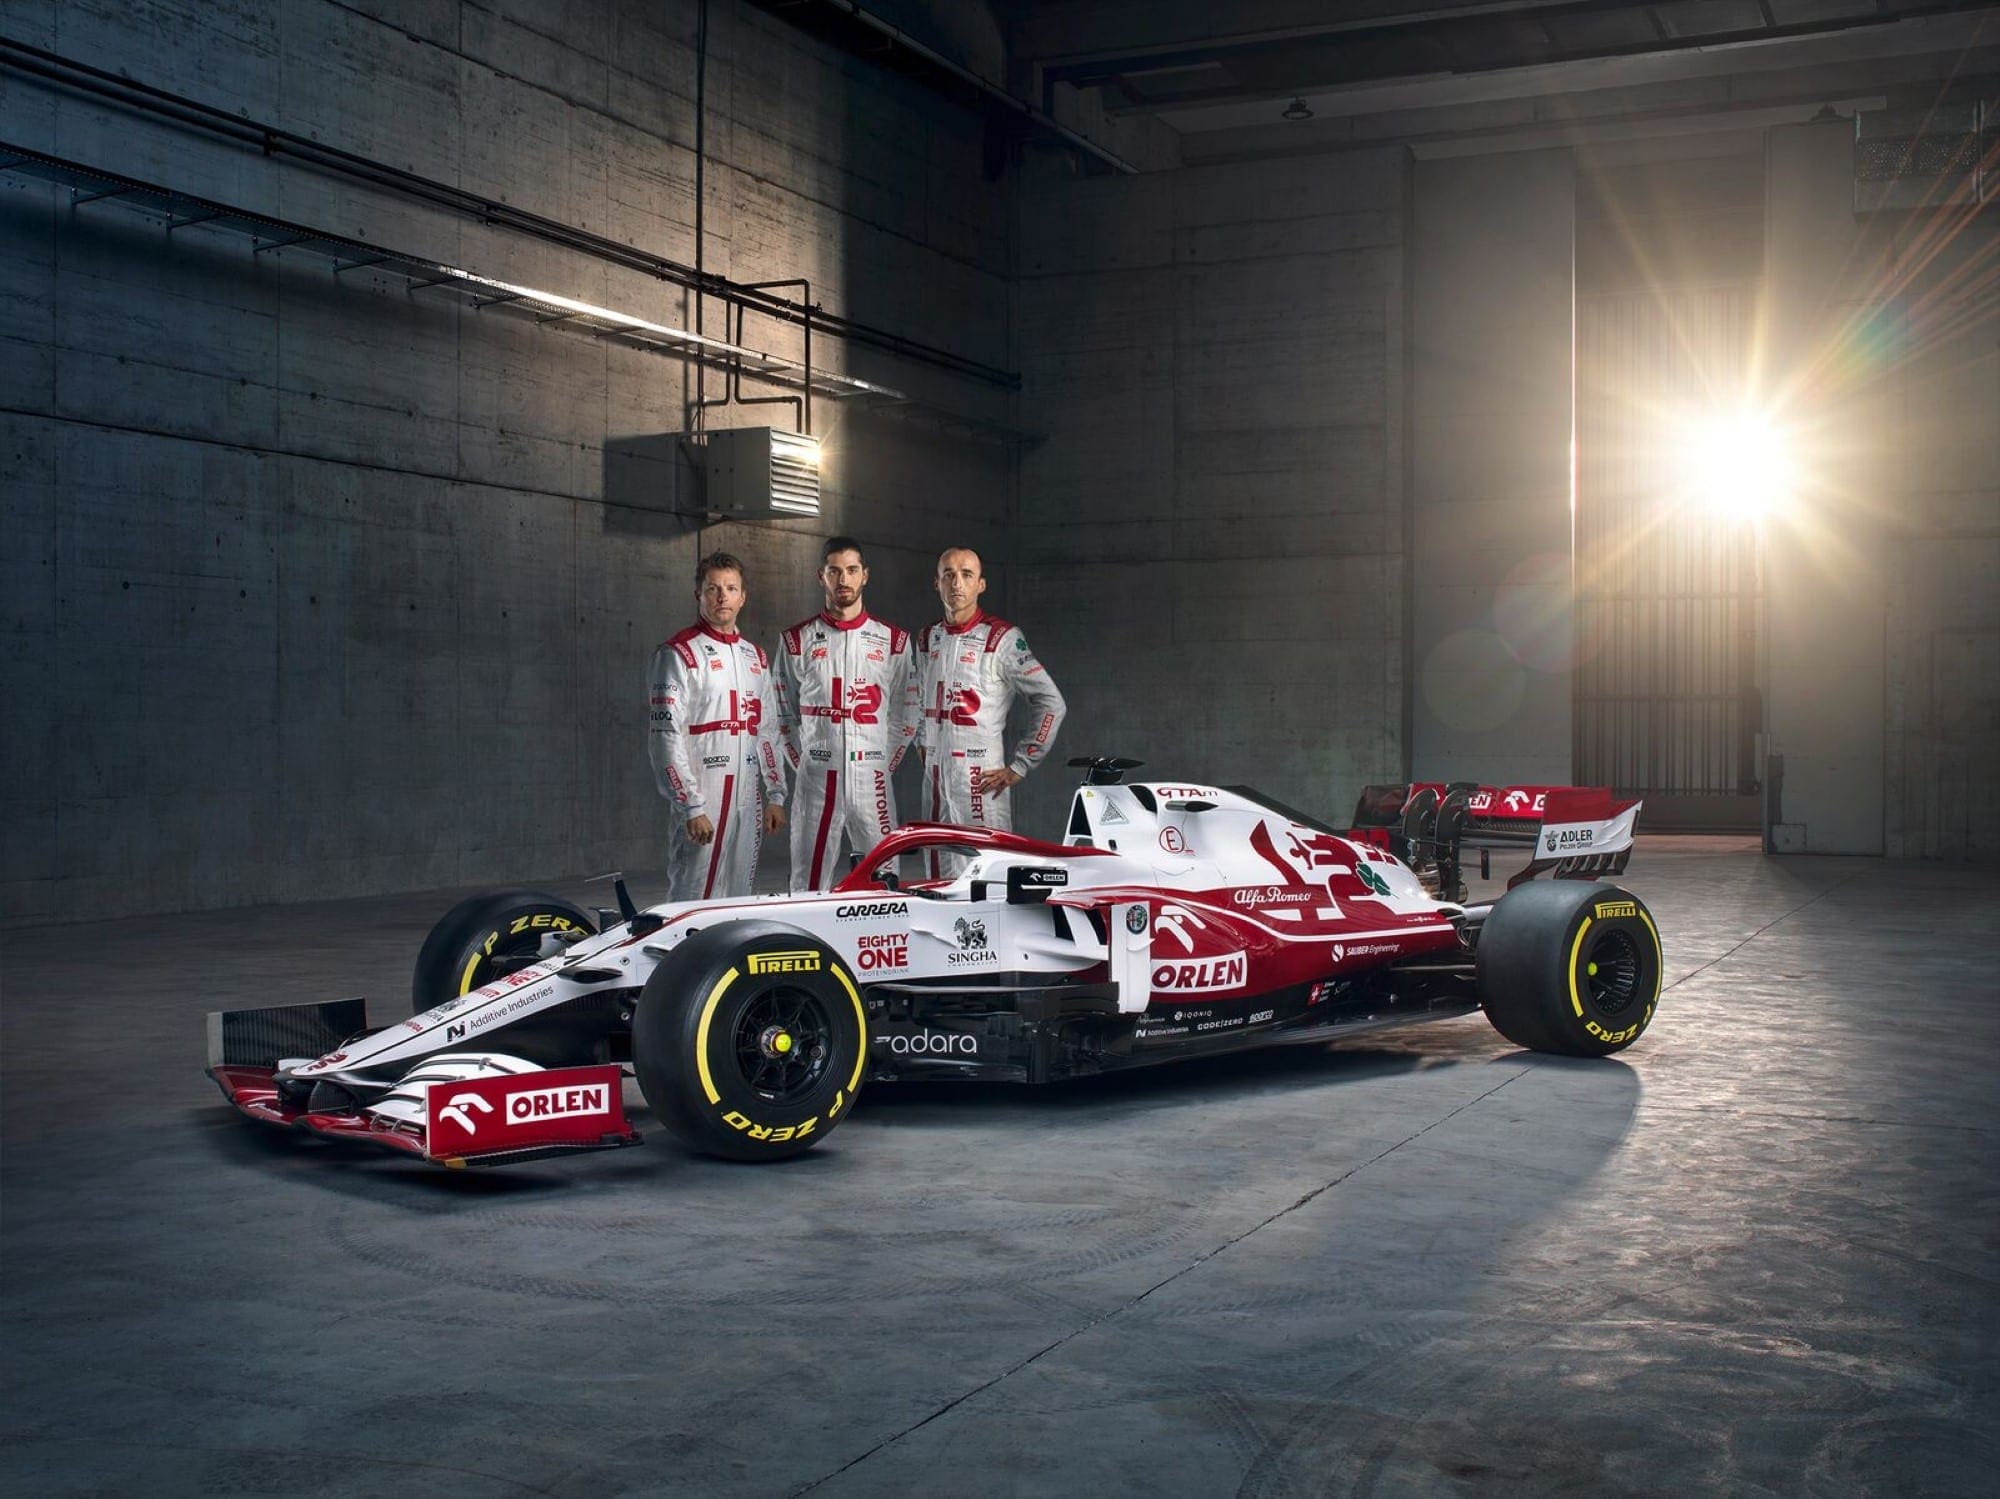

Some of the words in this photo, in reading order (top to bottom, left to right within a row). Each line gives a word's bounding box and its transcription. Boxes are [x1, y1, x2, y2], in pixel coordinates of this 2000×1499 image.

[873, 769, 892, 836] ANTONIO
[1560, 829, 1593, 843] ADLER
[836, 902, 909, 918] CARRERA
[1234, 889, 1267, 910] Alfa
[1266, 886, 1311, 903] Romeo
[1595, 901, 1636, 919] PIRELLI
[857, 933, 909, 949] EIGHTY
[747, 951, 821, 974] PIRELLI
[857, 947, 908, 970] ONE
[947, 950, 998, 964] SINGHA
[1152, 957, 1243, 988] ORLEN
[470, 1006, 508, 1031] Additive
[508, 985, 554, 1012] Industries
[1585, 1010, 1639, 1043] ZERO
[891, 1027, 977, 1053] adara
[512, 1089, 601, 1119] ORLEN
[722, 1110, 819, 1142] ZERO
